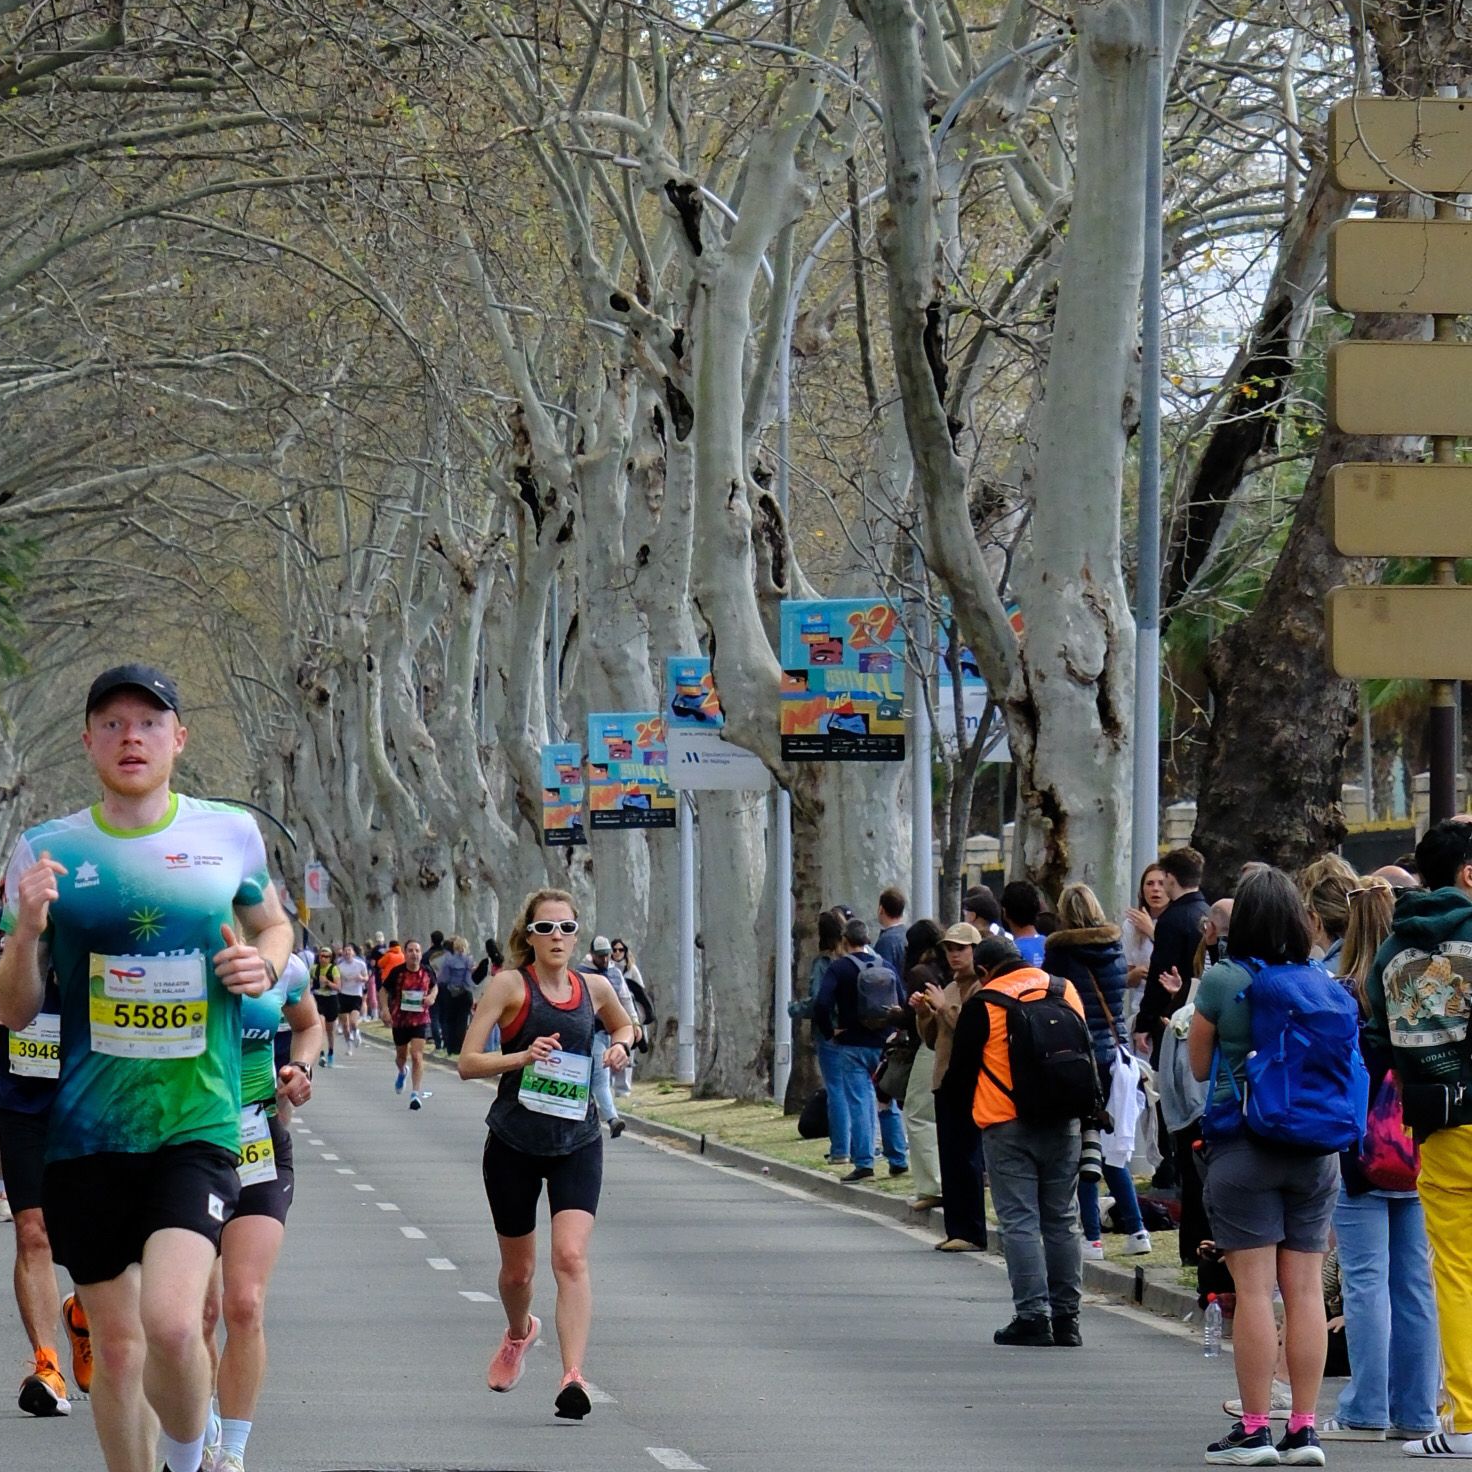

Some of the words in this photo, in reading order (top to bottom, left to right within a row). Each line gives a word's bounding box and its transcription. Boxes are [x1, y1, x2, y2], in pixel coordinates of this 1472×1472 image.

[848, 604, 895, 649] 29
[635, 717, 668, 748] 29
[114, 1004, 188, 1029] 5586
[18, 1041, 60, 1060] 3948
